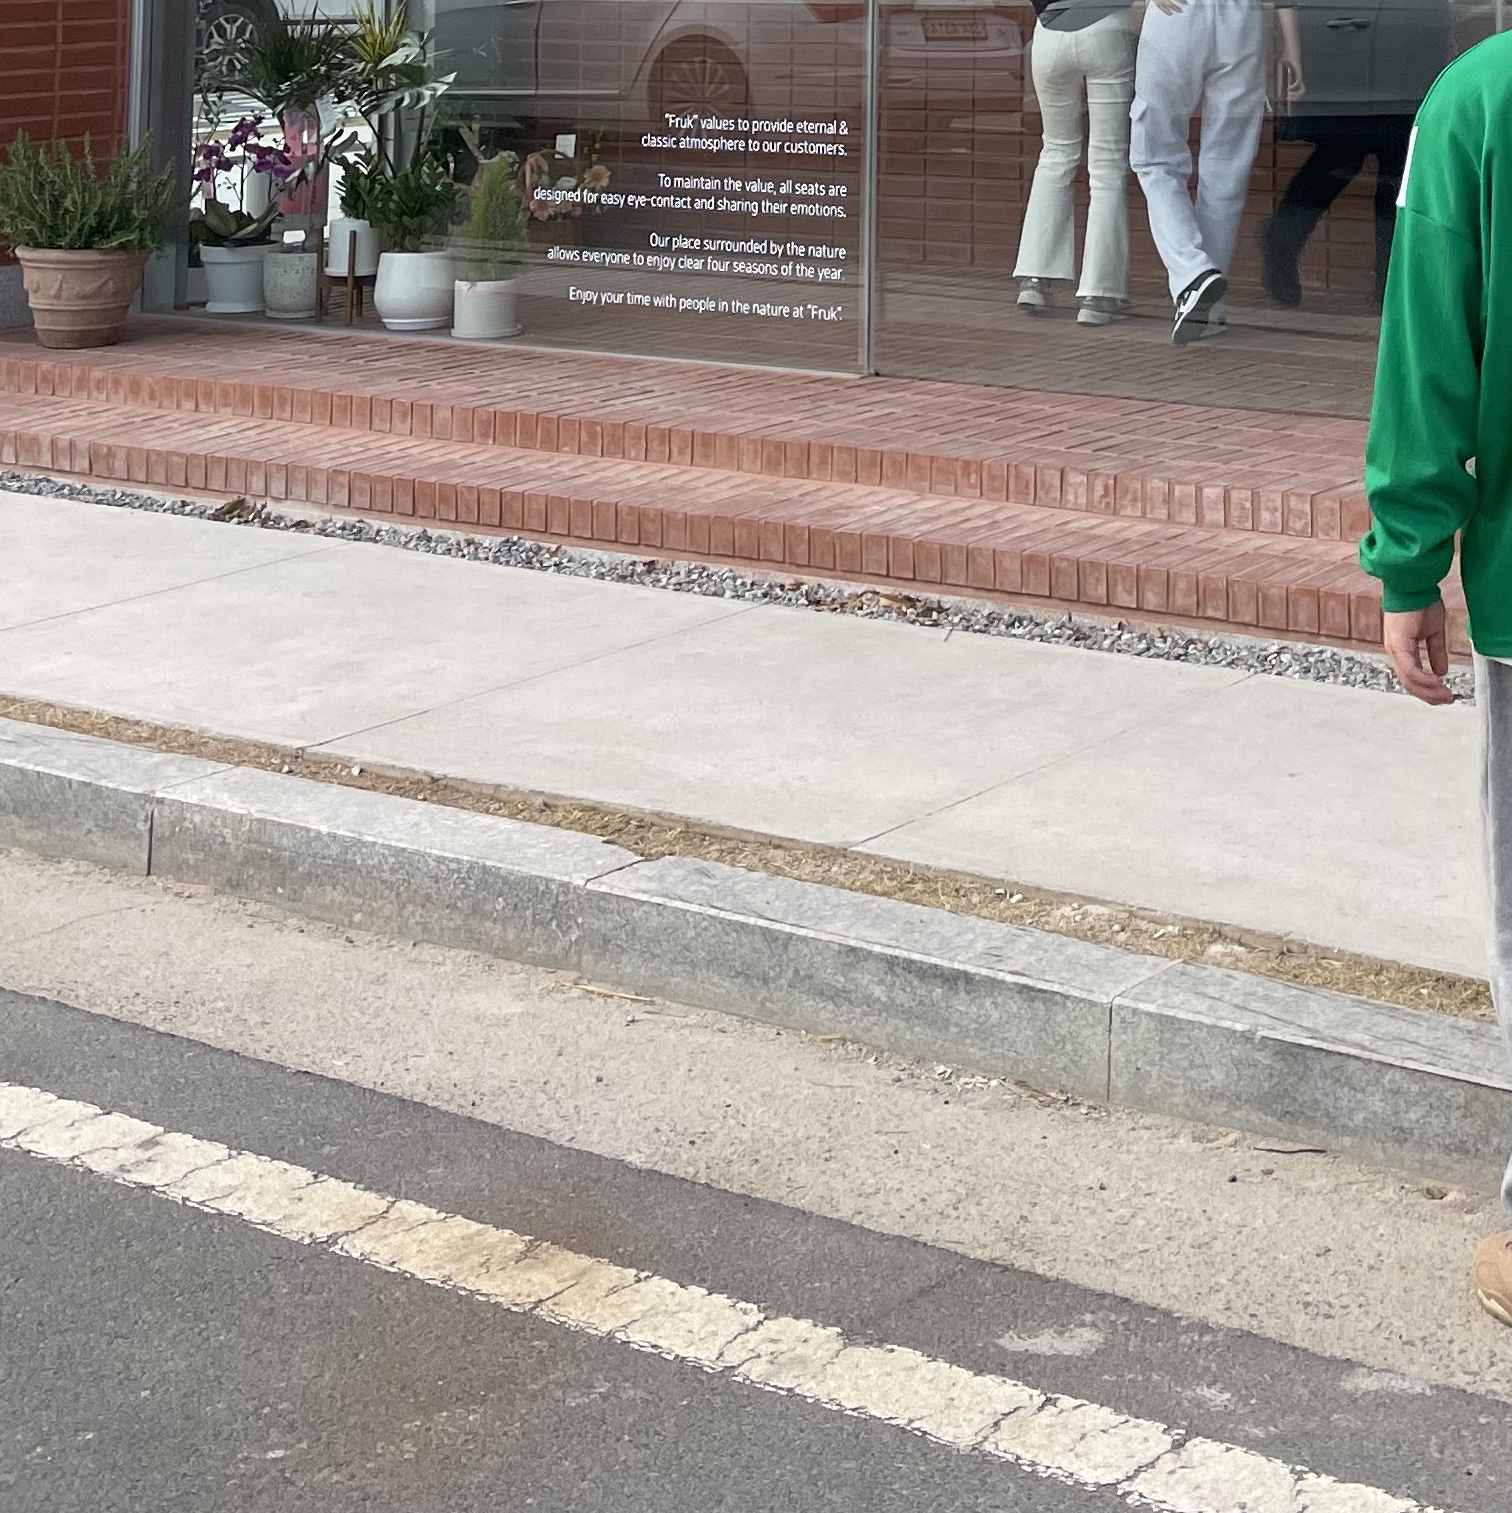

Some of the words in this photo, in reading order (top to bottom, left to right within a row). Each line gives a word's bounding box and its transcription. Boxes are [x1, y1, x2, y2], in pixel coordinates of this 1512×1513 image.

[700, 115, 735, 130] values
[737, 118, 749, 131] to
[752, 118, 793, 134] provide
[796, 120, 837, 134] eternal
[839, 120, 848, 135] &
[641, 133, 677, 148] classic
[679, 135, 745, 153] atmosphere
[748, 138, 760, 152] to
[762, 140, 782, 152] our
[784, 141, 847, 156] customers.
[658, 173, 671, 188] To
[673, 175, 721, 190] maintain
[724, 177, 742, 191] the
[745, 178, 776, 195] value,
[779, 180, 792, 194] all
[795, 182, 826, 196] seats
[828, 184, 847, 197] are
[533, 186, 581, 204] designed
[583, 189, 599, 203] for
[601, 193, 625, 208] easy
[627, 194, 692, 209] eye-contact
[694, 196, 715, 210] and
[717, 197, 758, 216] sharing
[762, 199, 788, 214] their
[790, 202, 847, 218] emotions.
[650, 232, 670, 247] Our
[672, 234, 700, 251] place
[703, 238, 767, 254] surrounded
[770, 240, 784, 258] by
[787, 241, 805, 256] the
[808, 244, 847, 259] nature
[547, 246, 580, 261] allows
[582, 250, 630, 266] everyone
[633, 252, 644, 265] to
[647, 254, 676, 271] enjoy
[678, 255, 704, 269] clear
[707, 256, 730, 271] four
[733, 261, 778, 276] seasons
[780, 261, 793, 276] of
[795, 263, 815, 277] the
[818, 267, 845, 281] year.
[569, 287, 598, 304] Enjoy
[601, 291, 624, 305] your
[627, 290, 651, 306] time
[653, 293, 677, 308] with
[679, 296, 716, 313] people
[718, 298, 729, 312] in
[731, 299, 750, 314] the
[753, 303, 790, 318] nature
[792, 305, 804, 318] at
